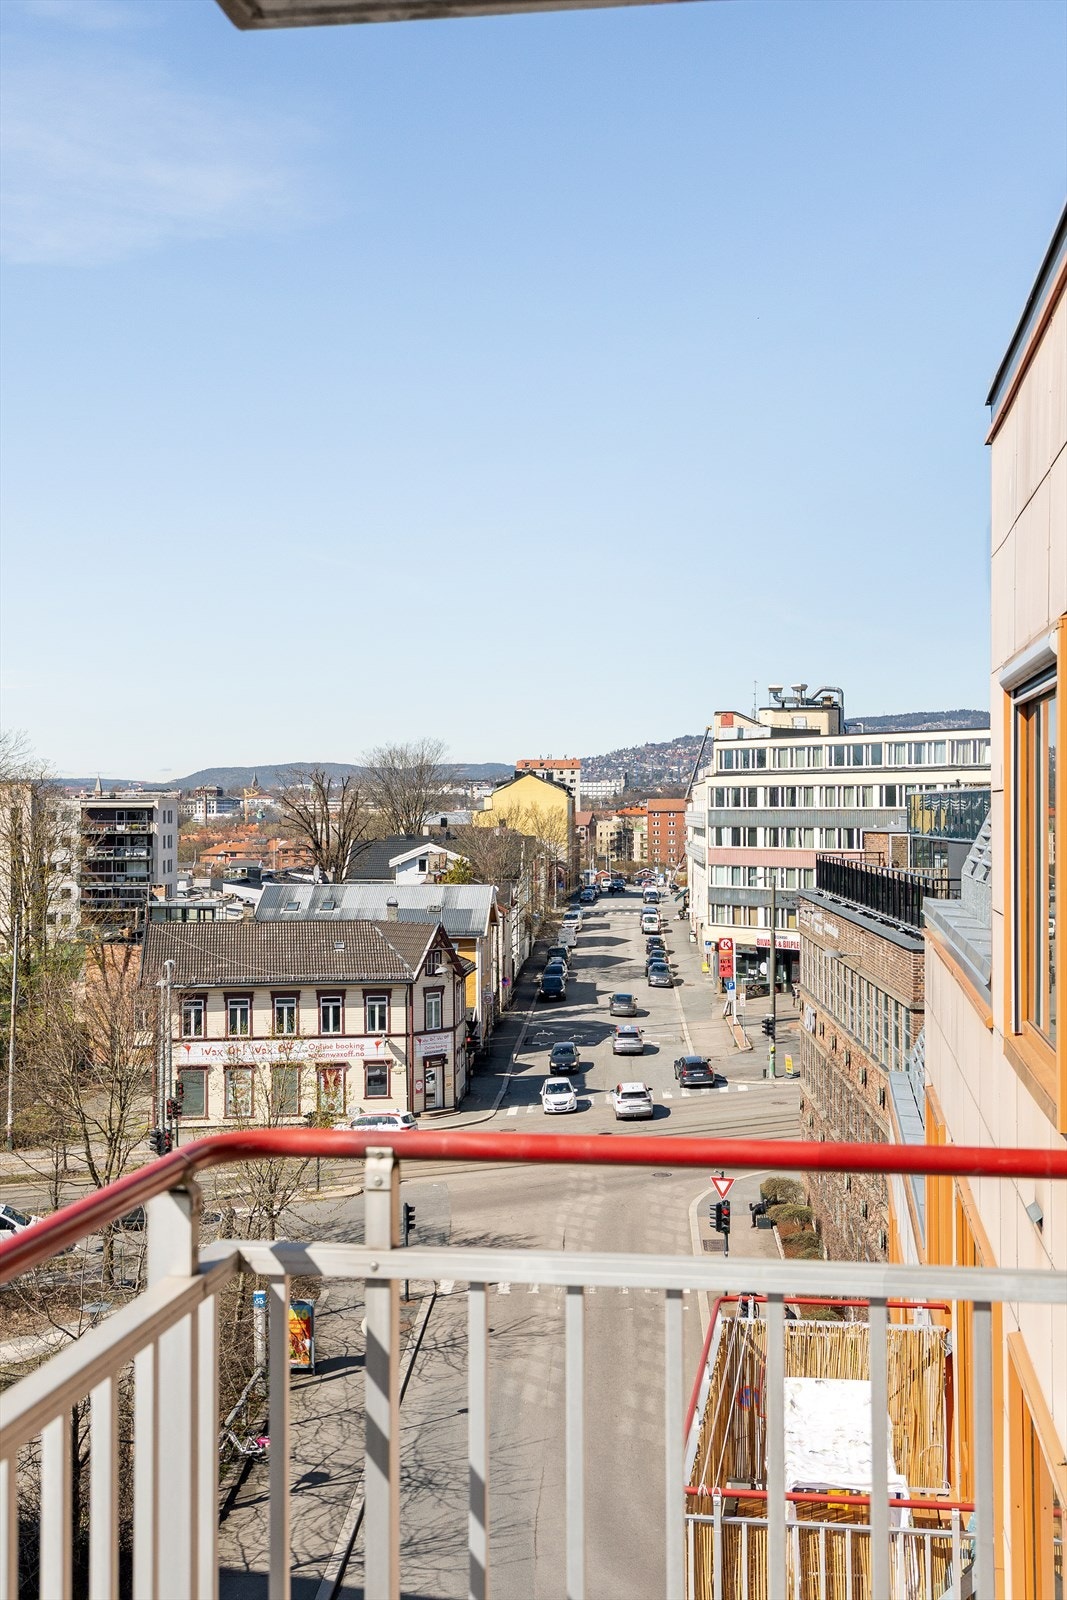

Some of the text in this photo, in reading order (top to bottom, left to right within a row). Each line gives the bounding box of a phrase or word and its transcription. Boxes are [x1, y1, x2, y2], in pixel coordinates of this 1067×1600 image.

[723, 941, 730, 949] K
[201, 1046, 223, 1056] Wax
[251, 1045, 272, 1055] Wax
[335, 1043, 365, 1051] booking
